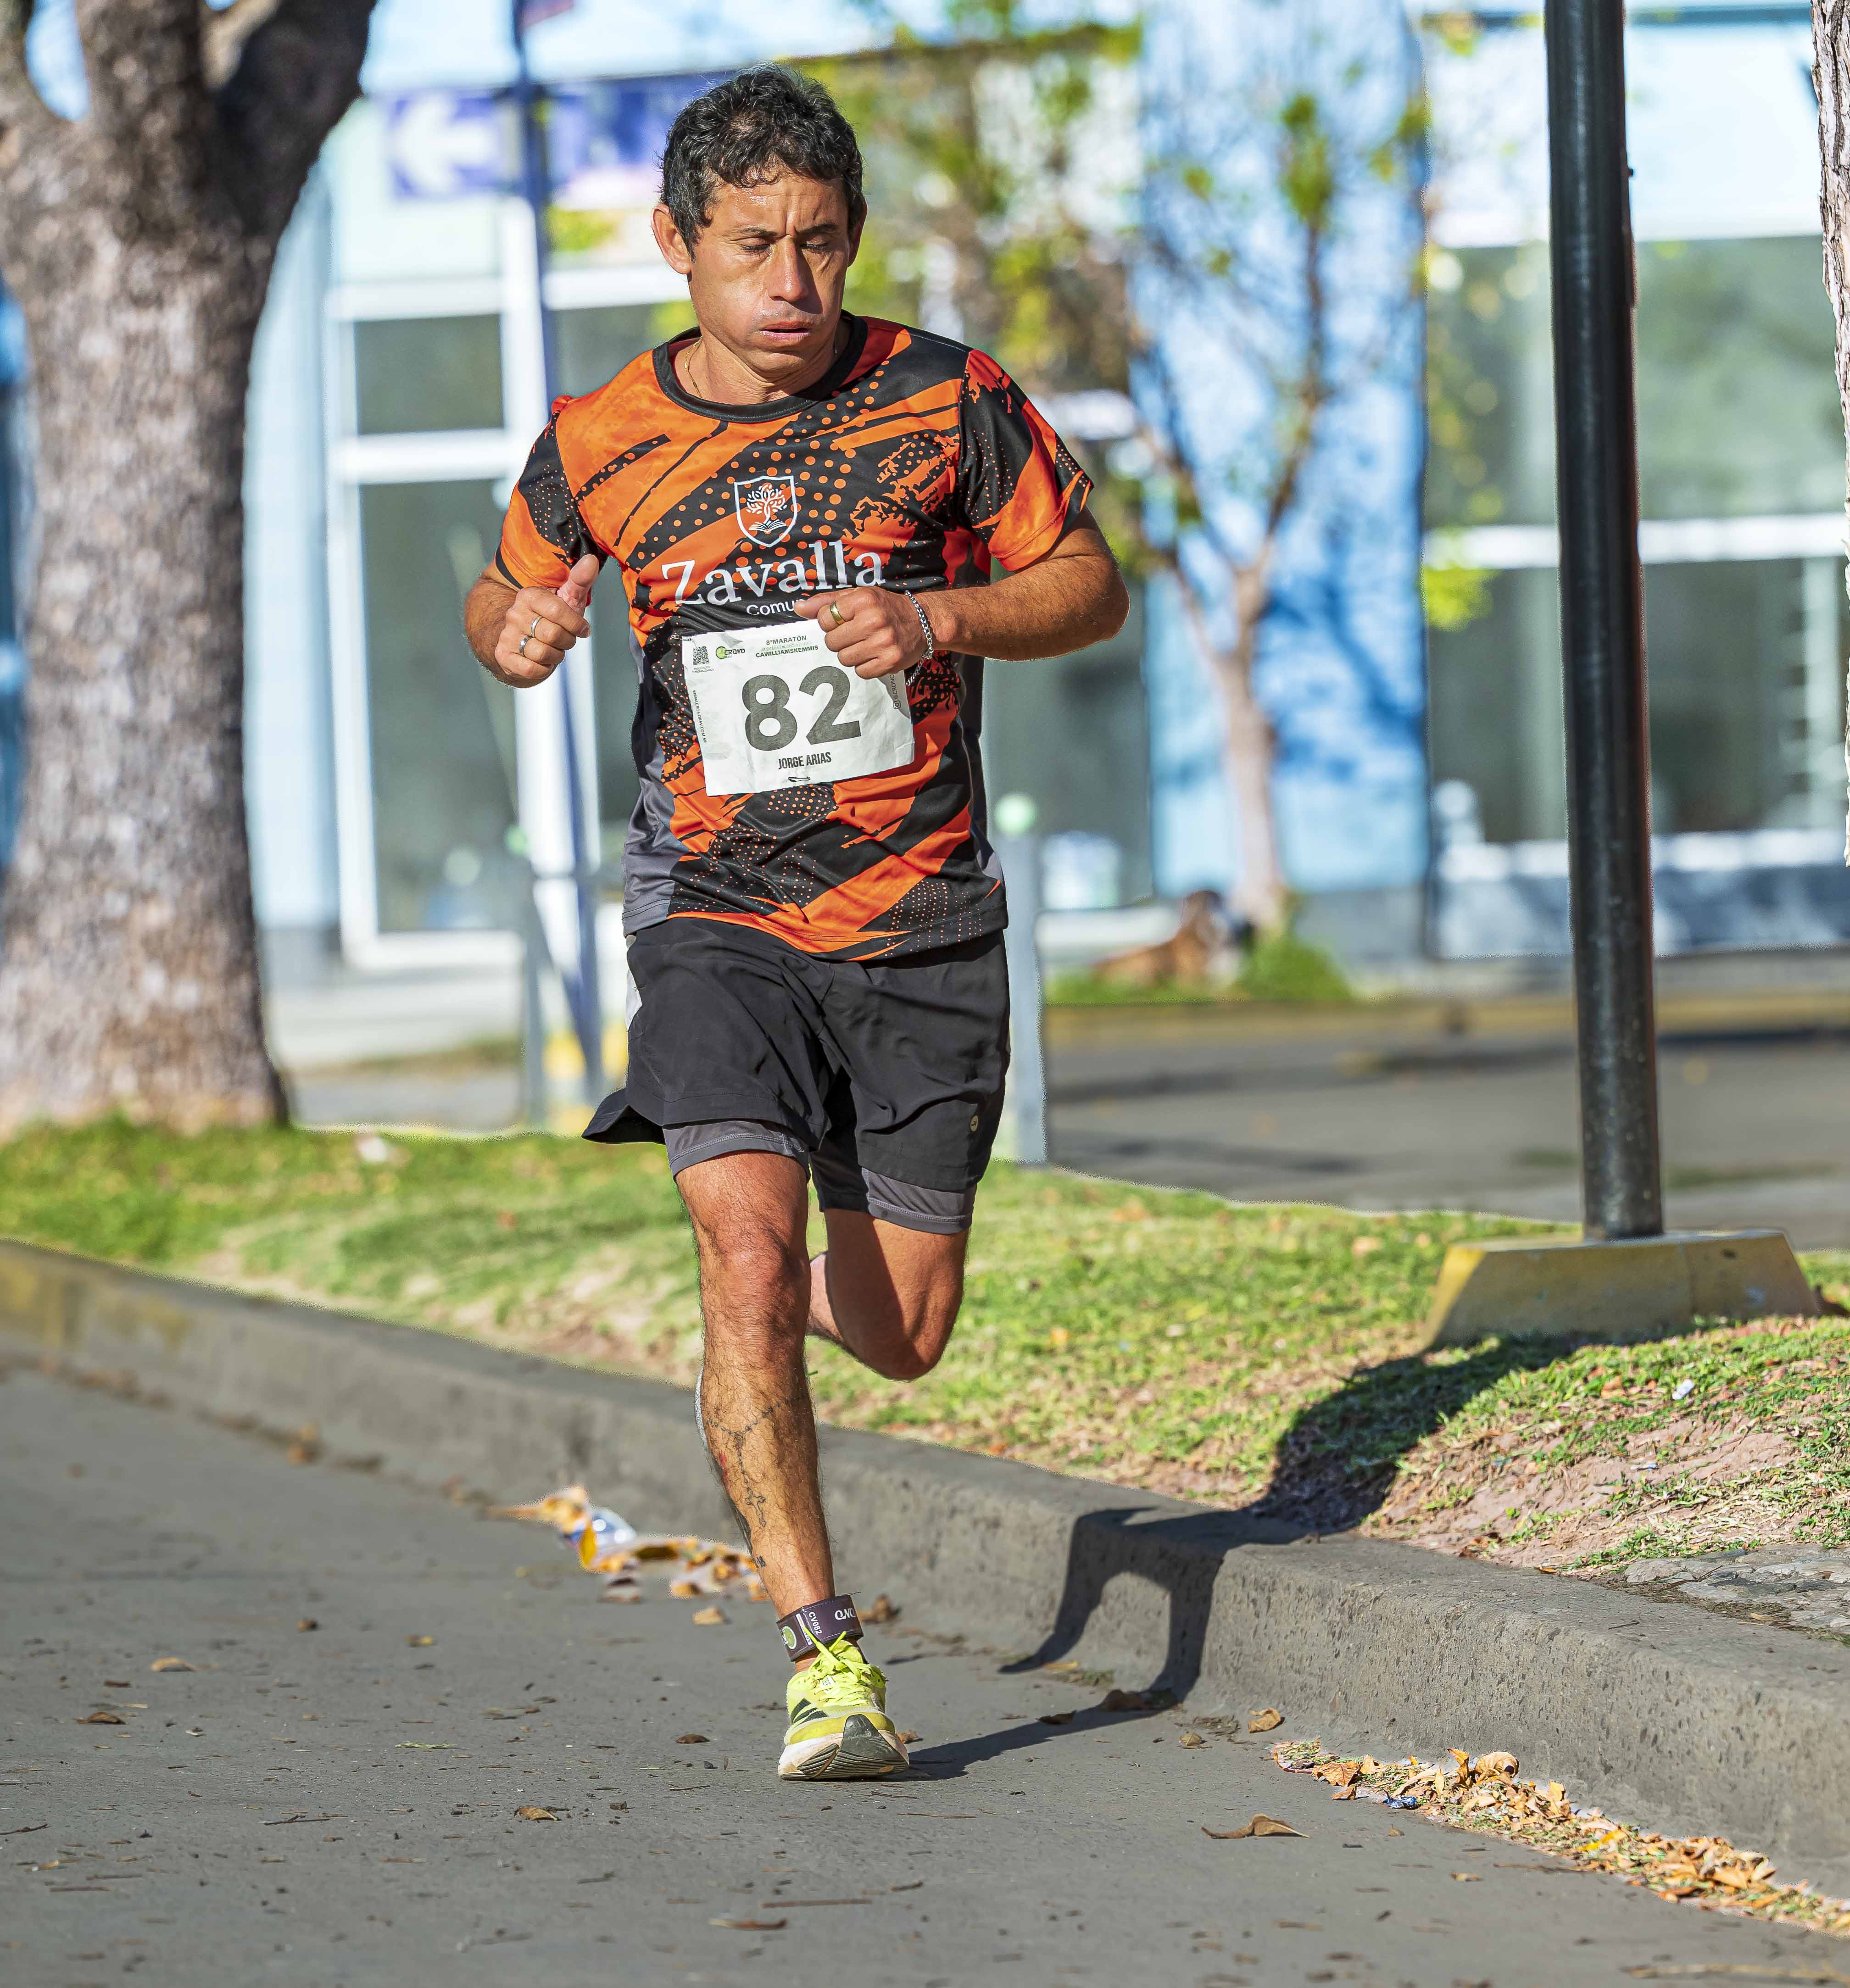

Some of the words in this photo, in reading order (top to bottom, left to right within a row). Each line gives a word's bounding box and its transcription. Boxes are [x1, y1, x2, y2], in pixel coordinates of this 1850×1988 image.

[662, 540, 886, 605] Zavalla
[746, 599, 804, 615] comu
[742, 666, 862, 751] 82
[778, 756, 804, 769] JORGE
[806, 752, 831, 766] ARIAS
[808, 1611, 822, 1635] CV082
